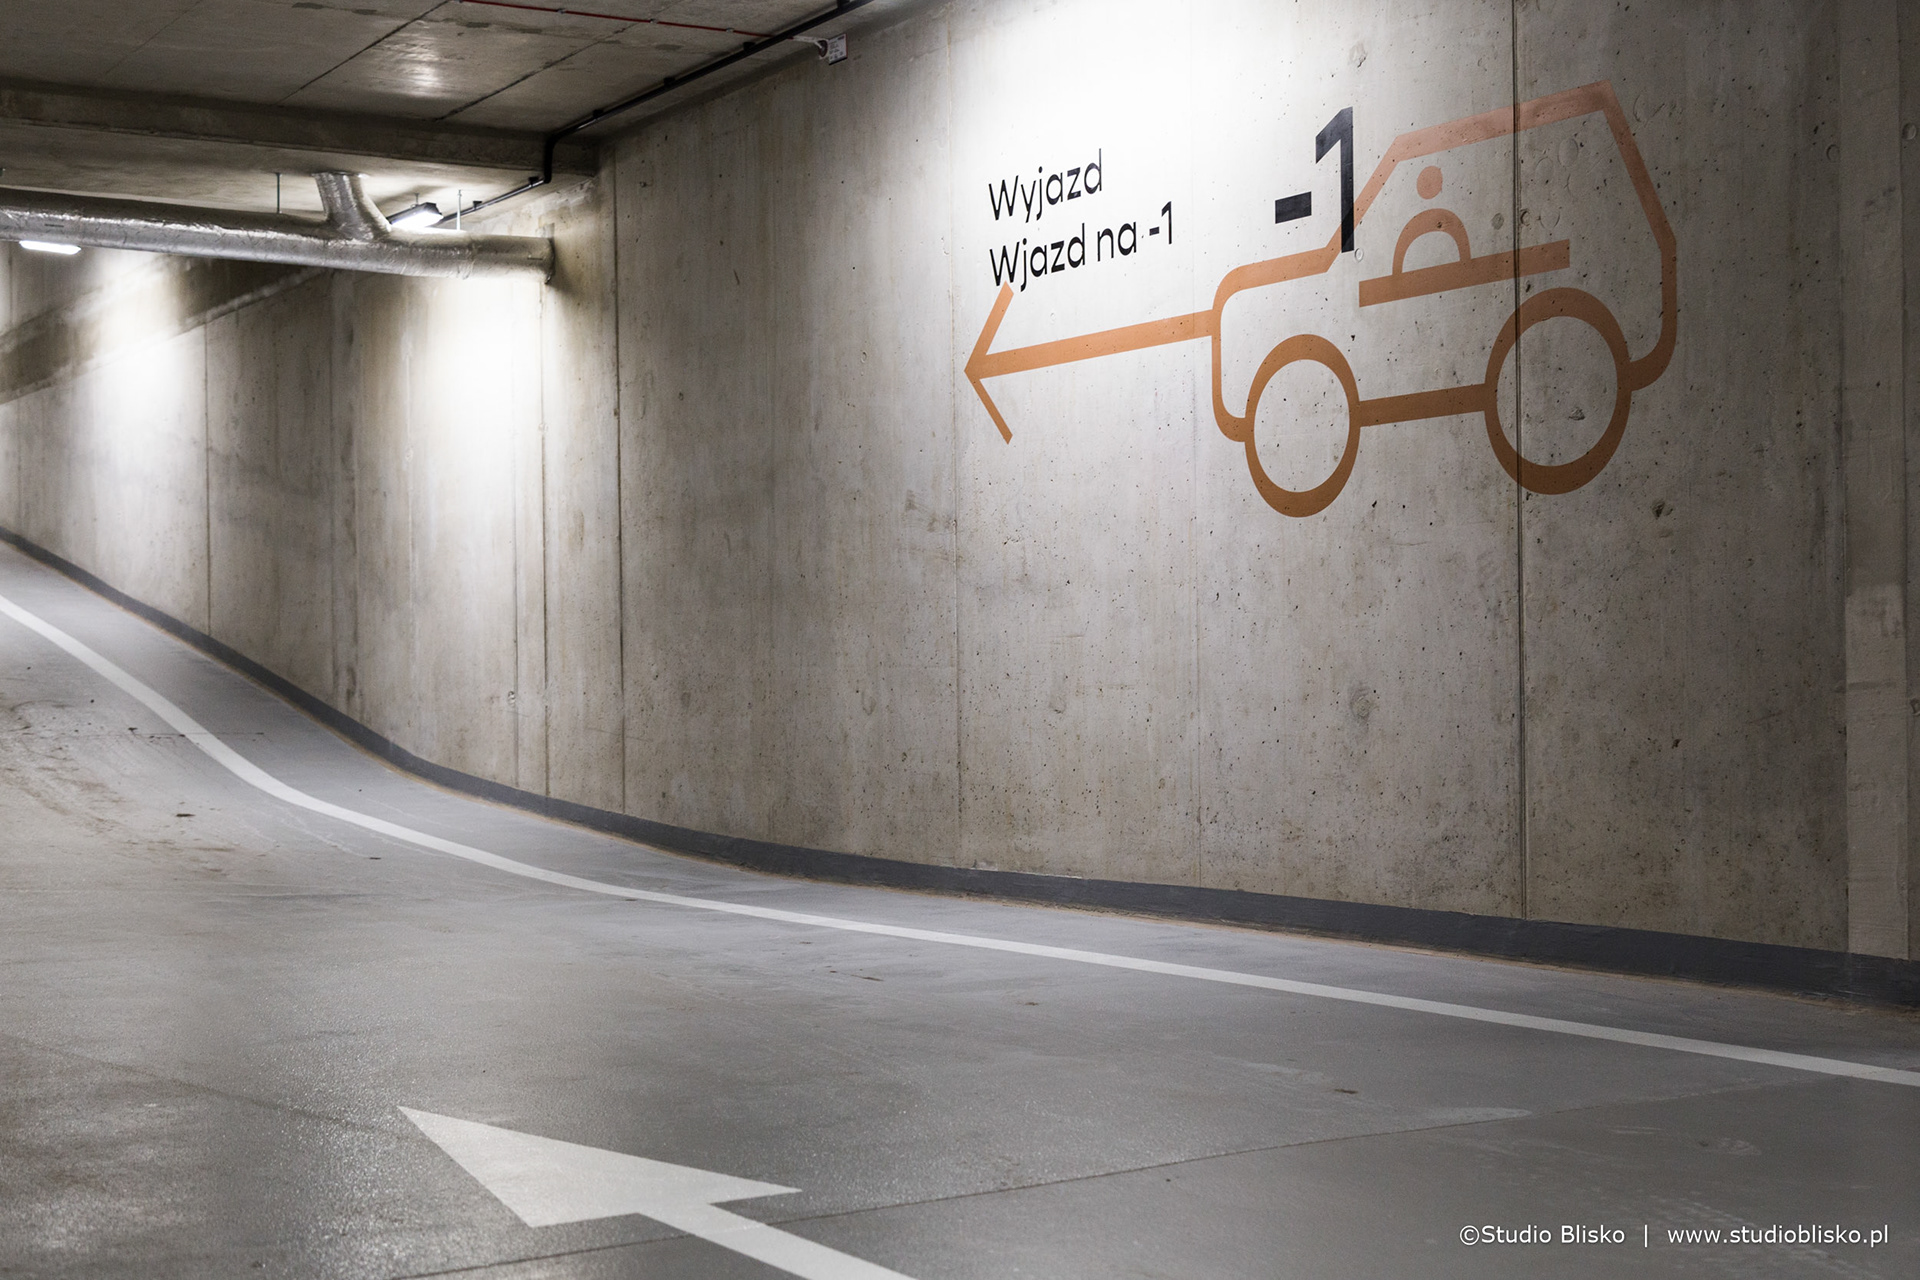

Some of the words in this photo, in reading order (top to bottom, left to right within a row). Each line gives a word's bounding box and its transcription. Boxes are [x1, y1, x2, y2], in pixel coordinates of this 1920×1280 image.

[988, 148, 1102, 223] Wyjazd
[1275, 106, 1354, 253] -1
[989, 222, 1085, 292] Wjazd
[1097, 221, 1137, 262] na
[1149, 200, 1173, 245] -1
